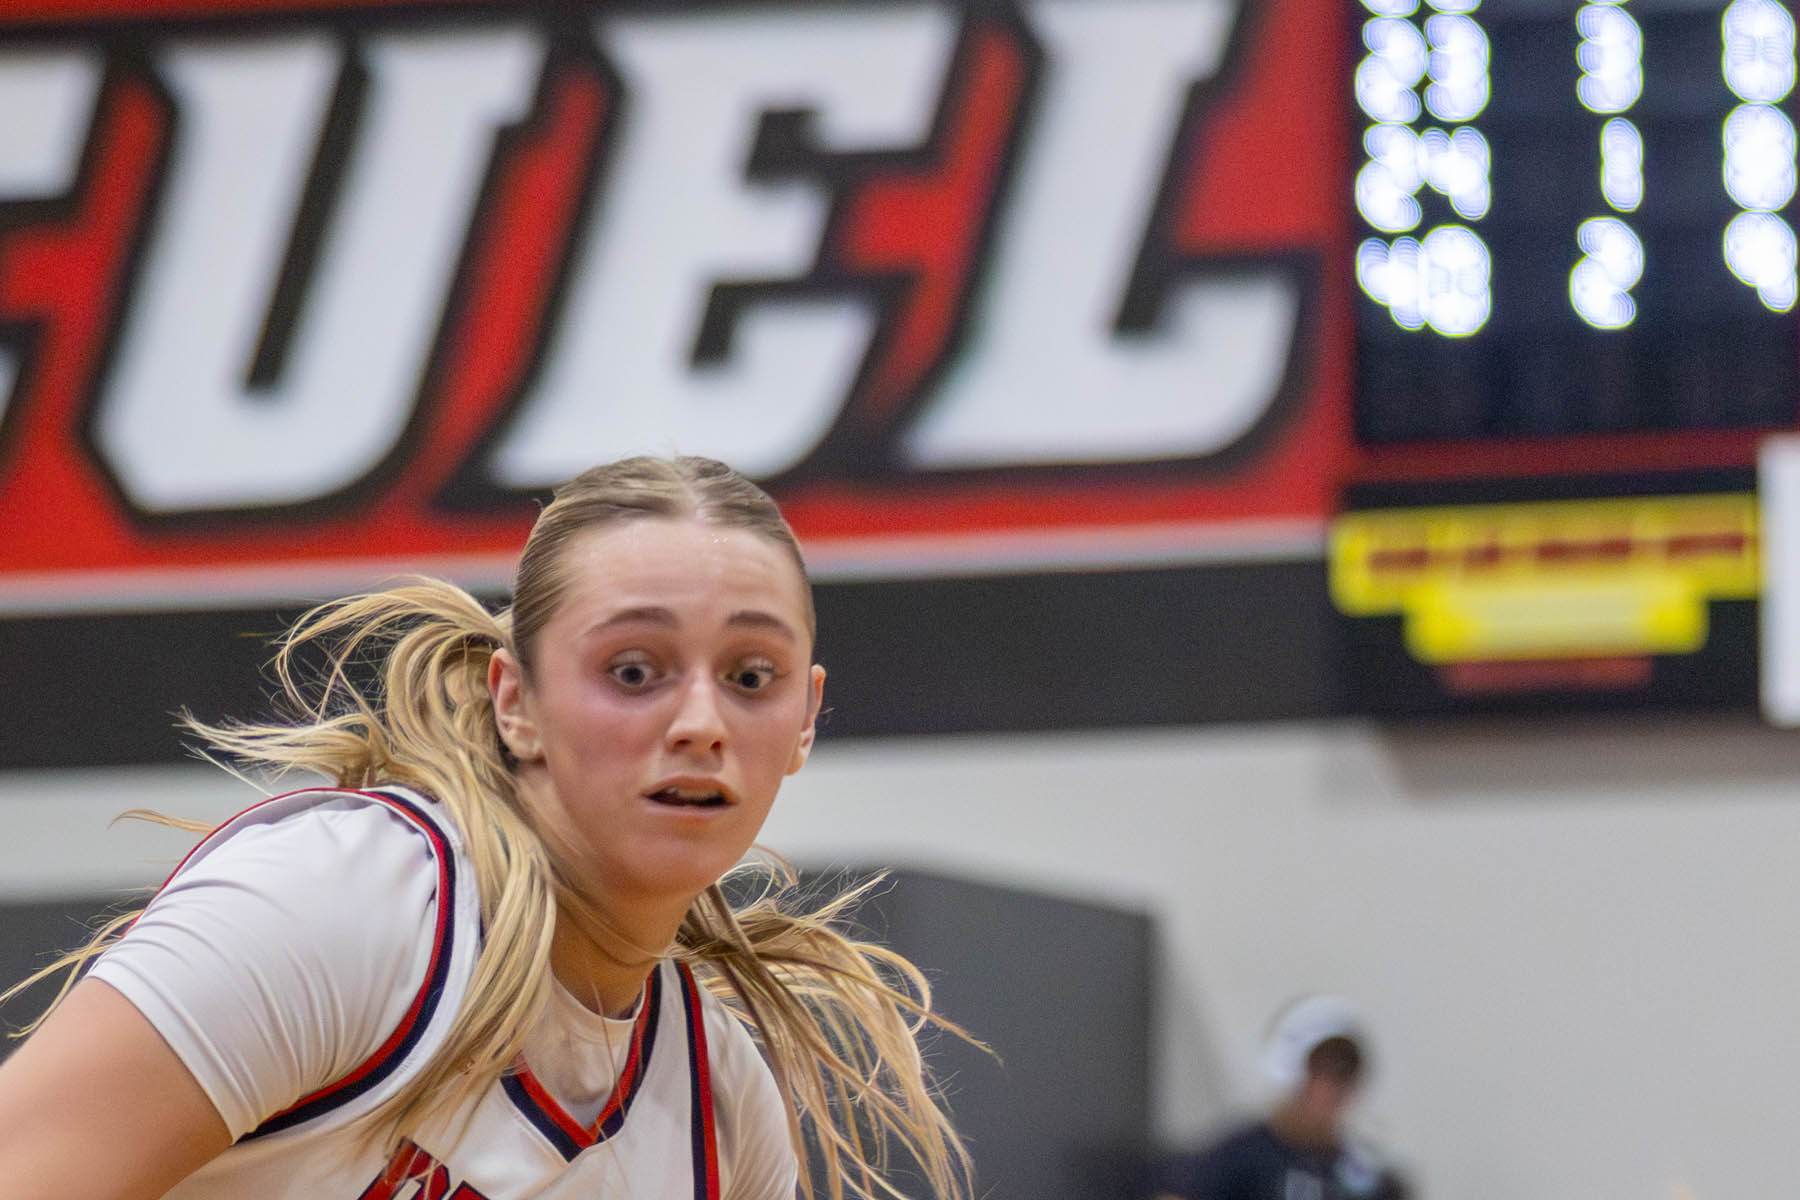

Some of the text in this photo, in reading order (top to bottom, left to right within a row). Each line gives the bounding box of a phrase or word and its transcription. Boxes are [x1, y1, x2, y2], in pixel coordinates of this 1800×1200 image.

[1356, 14, 1490, 123] 23
[1576, 4, 1642, 113] 3
[1356, 122, 1490, 233] 24
[1570, 216, 1644, 330] 2
